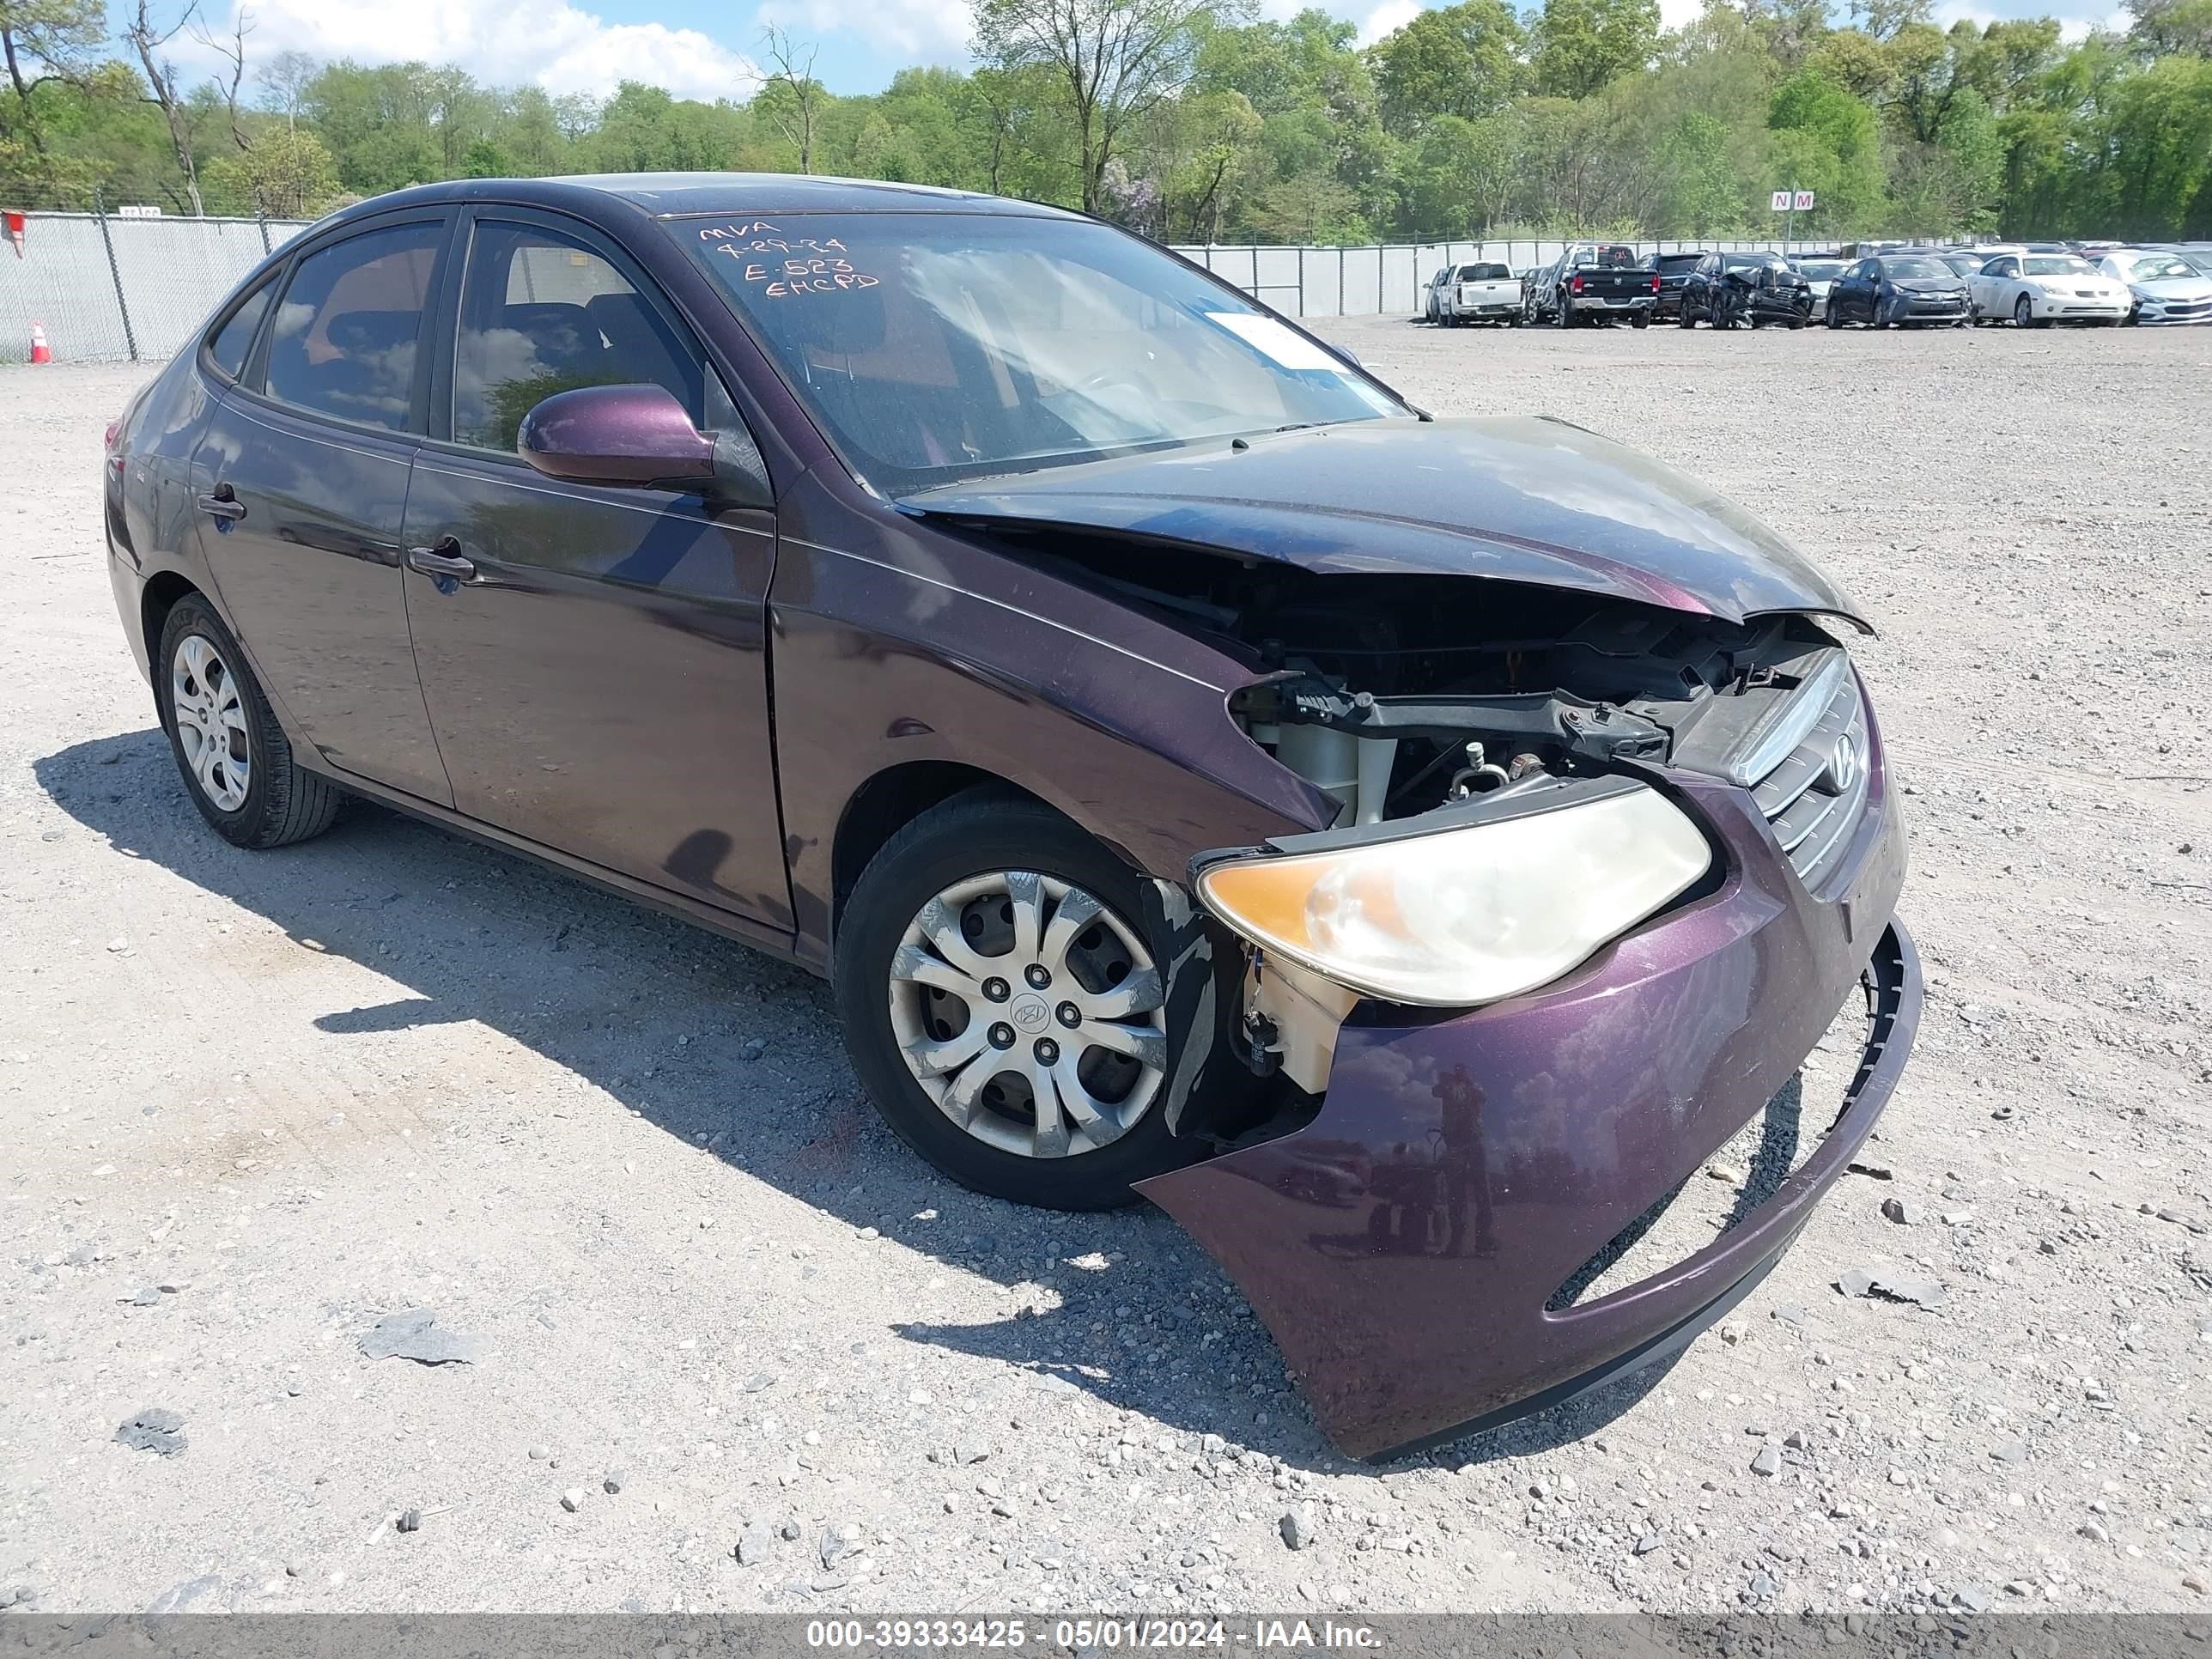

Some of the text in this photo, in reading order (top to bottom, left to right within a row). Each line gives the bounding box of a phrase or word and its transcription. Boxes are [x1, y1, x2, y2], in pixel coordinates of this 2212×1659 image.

[1776, 194, 1787, 207] N
[1797, 194, 1811, 207] M
[699, 221, 782, 241] MVA
